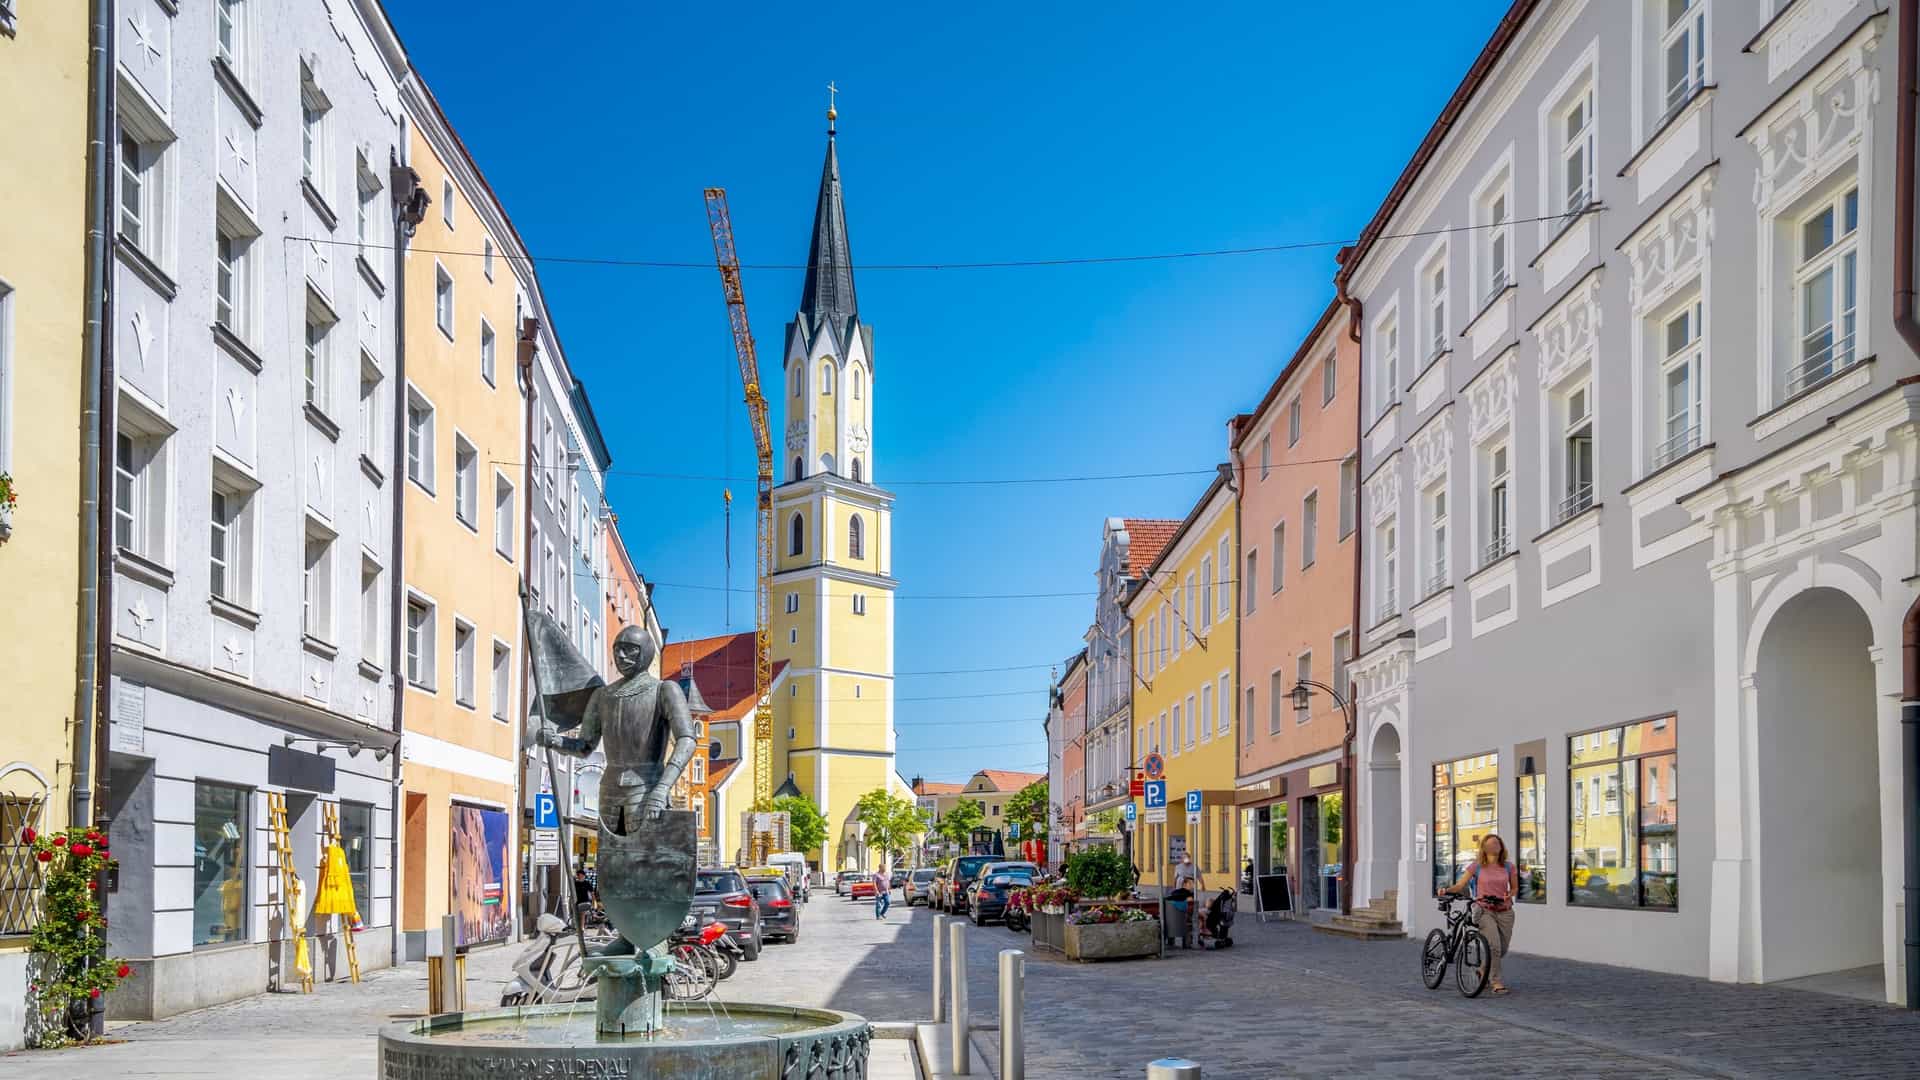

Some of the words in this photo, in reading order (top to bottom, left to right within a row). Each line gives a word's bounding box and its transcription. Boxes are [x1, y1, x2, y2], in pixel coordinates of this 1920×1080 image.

[1147, 783, 1160, 805] P
[1188, 793, 1197, 810] P
[540, 798, 554, 824] P
[1127, 804, 1134, 818] P
